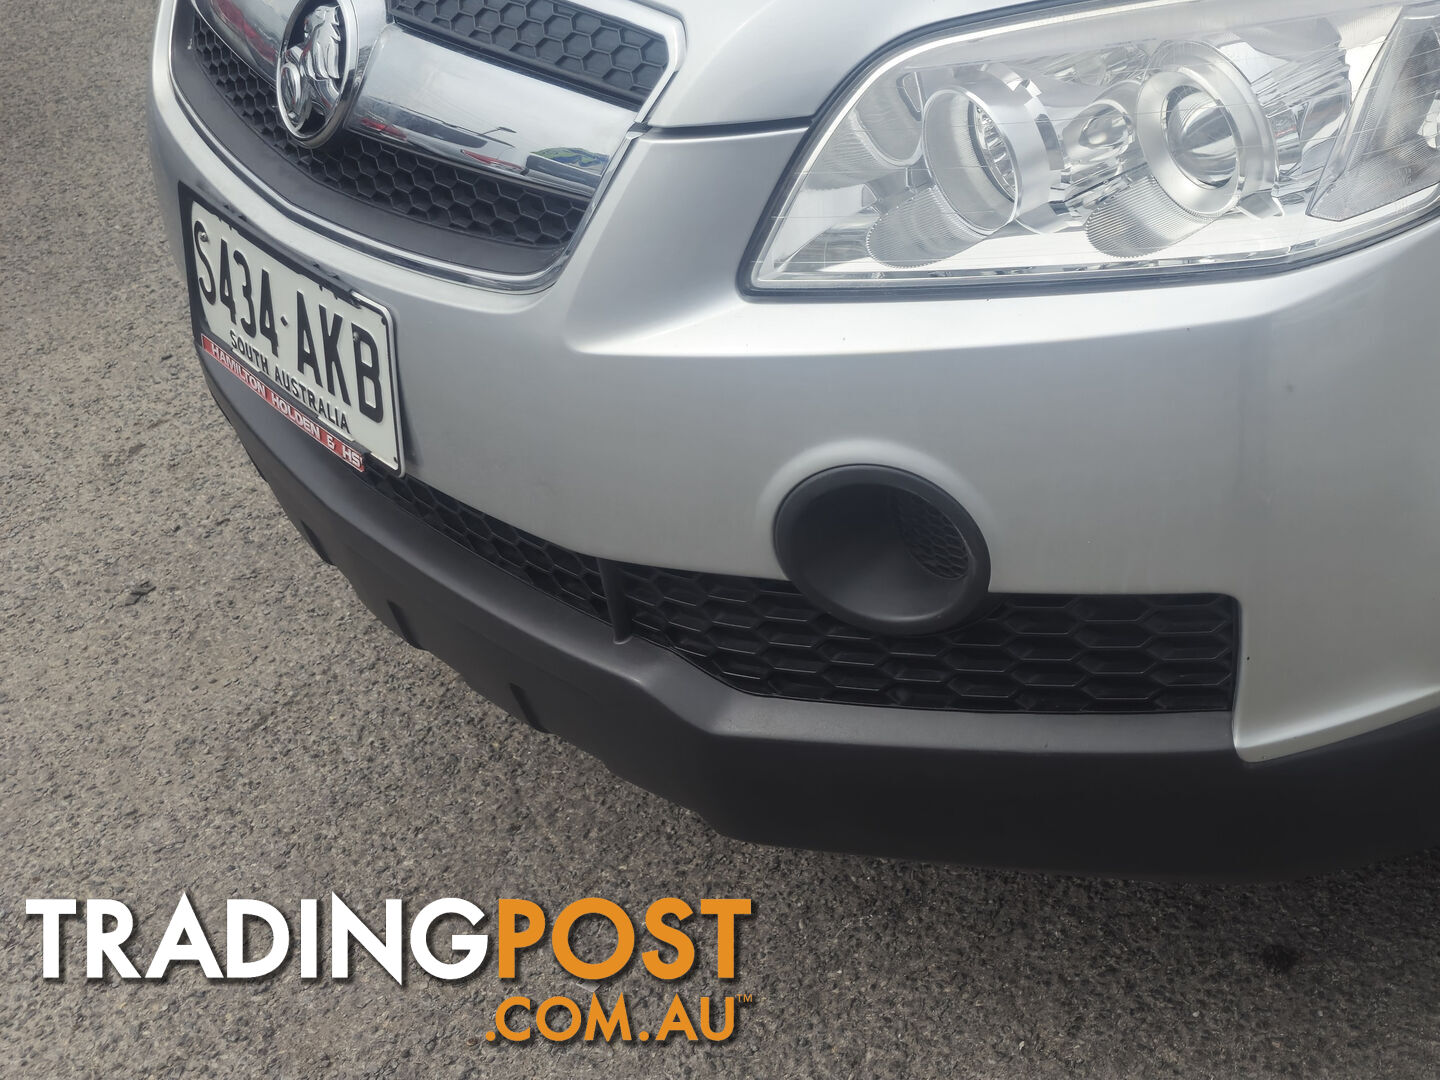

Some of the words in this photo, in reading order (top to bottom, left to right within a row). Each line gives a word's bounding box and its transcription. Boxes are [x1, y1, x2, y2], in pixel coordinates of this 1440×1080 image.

[210, 342, 267, 400] HAMILTON
[271, 391, 320, 440] HOLDEN
[229, 328, 268, 374] SOUTH
[275, 369, 352, 435] AUSTRALIA
